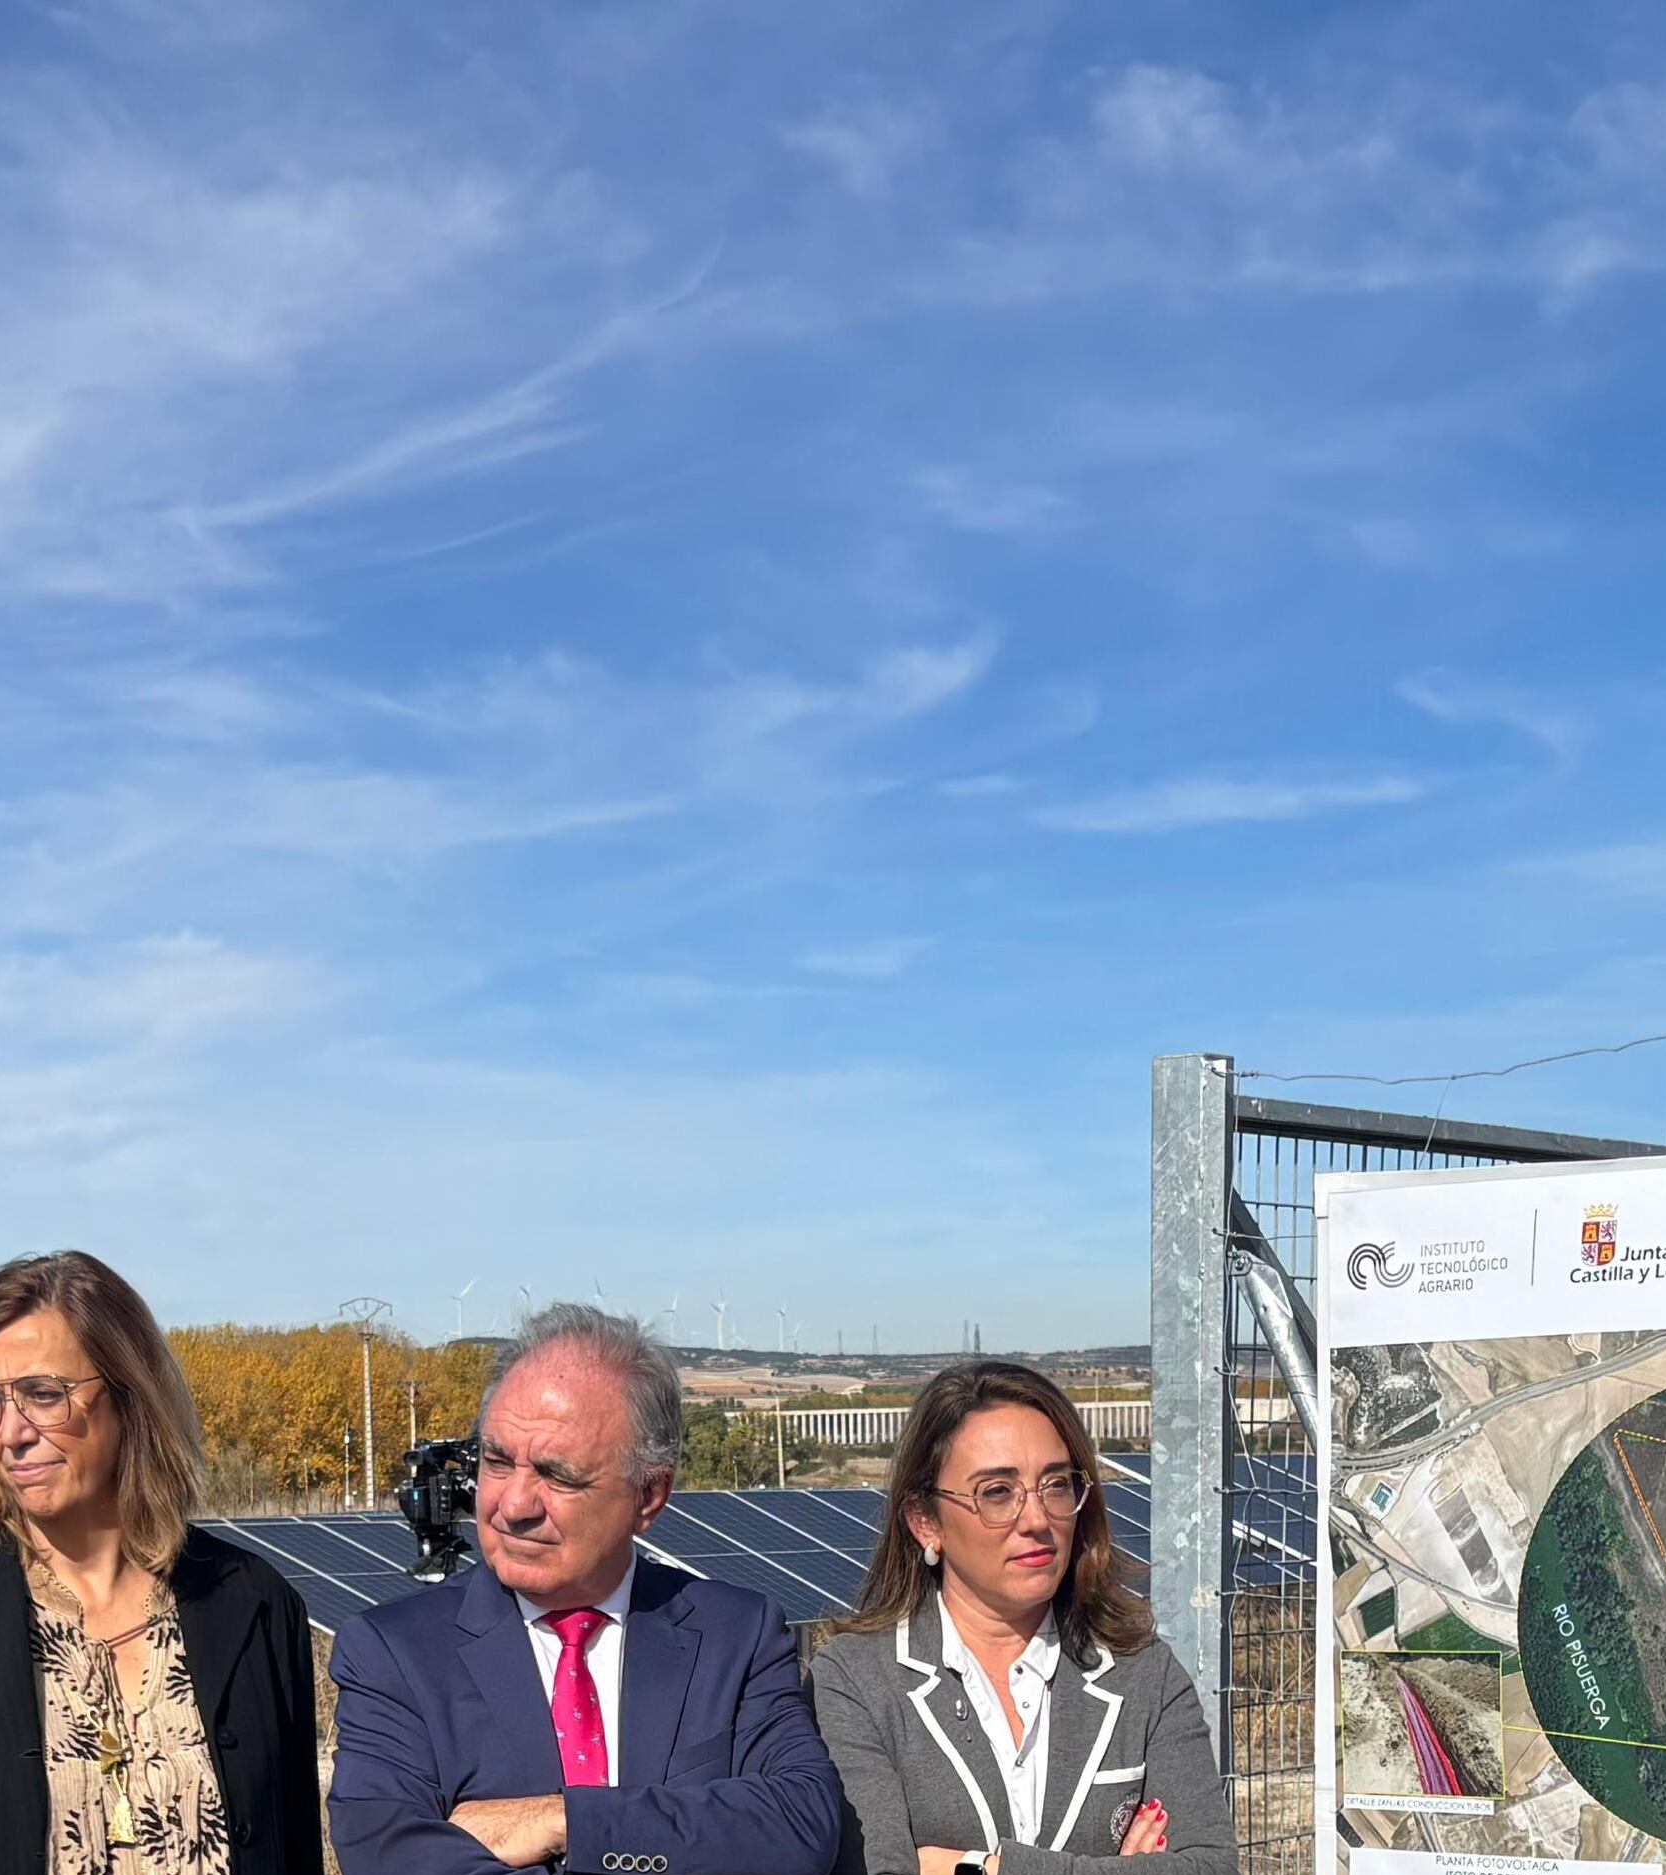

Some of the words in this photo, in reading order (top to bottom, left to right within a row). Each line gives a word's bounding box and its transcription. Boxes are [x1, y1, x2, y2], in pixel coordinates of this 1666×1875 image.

[1420, 1240, 1485, 1257] INSTITUTO
[1420, 1257, 1508, 1275] TECNOLÓGICO
[1570, 1265, 1633, 1284] Castilla
[1637, 1268, 1650, 1284] y
[1418, 1278, 1473, 1293] AGRARIO
[1552, 1603, 1574, 1637] RIO
[1565, 1639, 1610, 1730] PISUERGA
[1436, 1855, 1473, 1867] PLANTA
[1477, 1857, 1559, 1872] FOTOVOLTAICA
